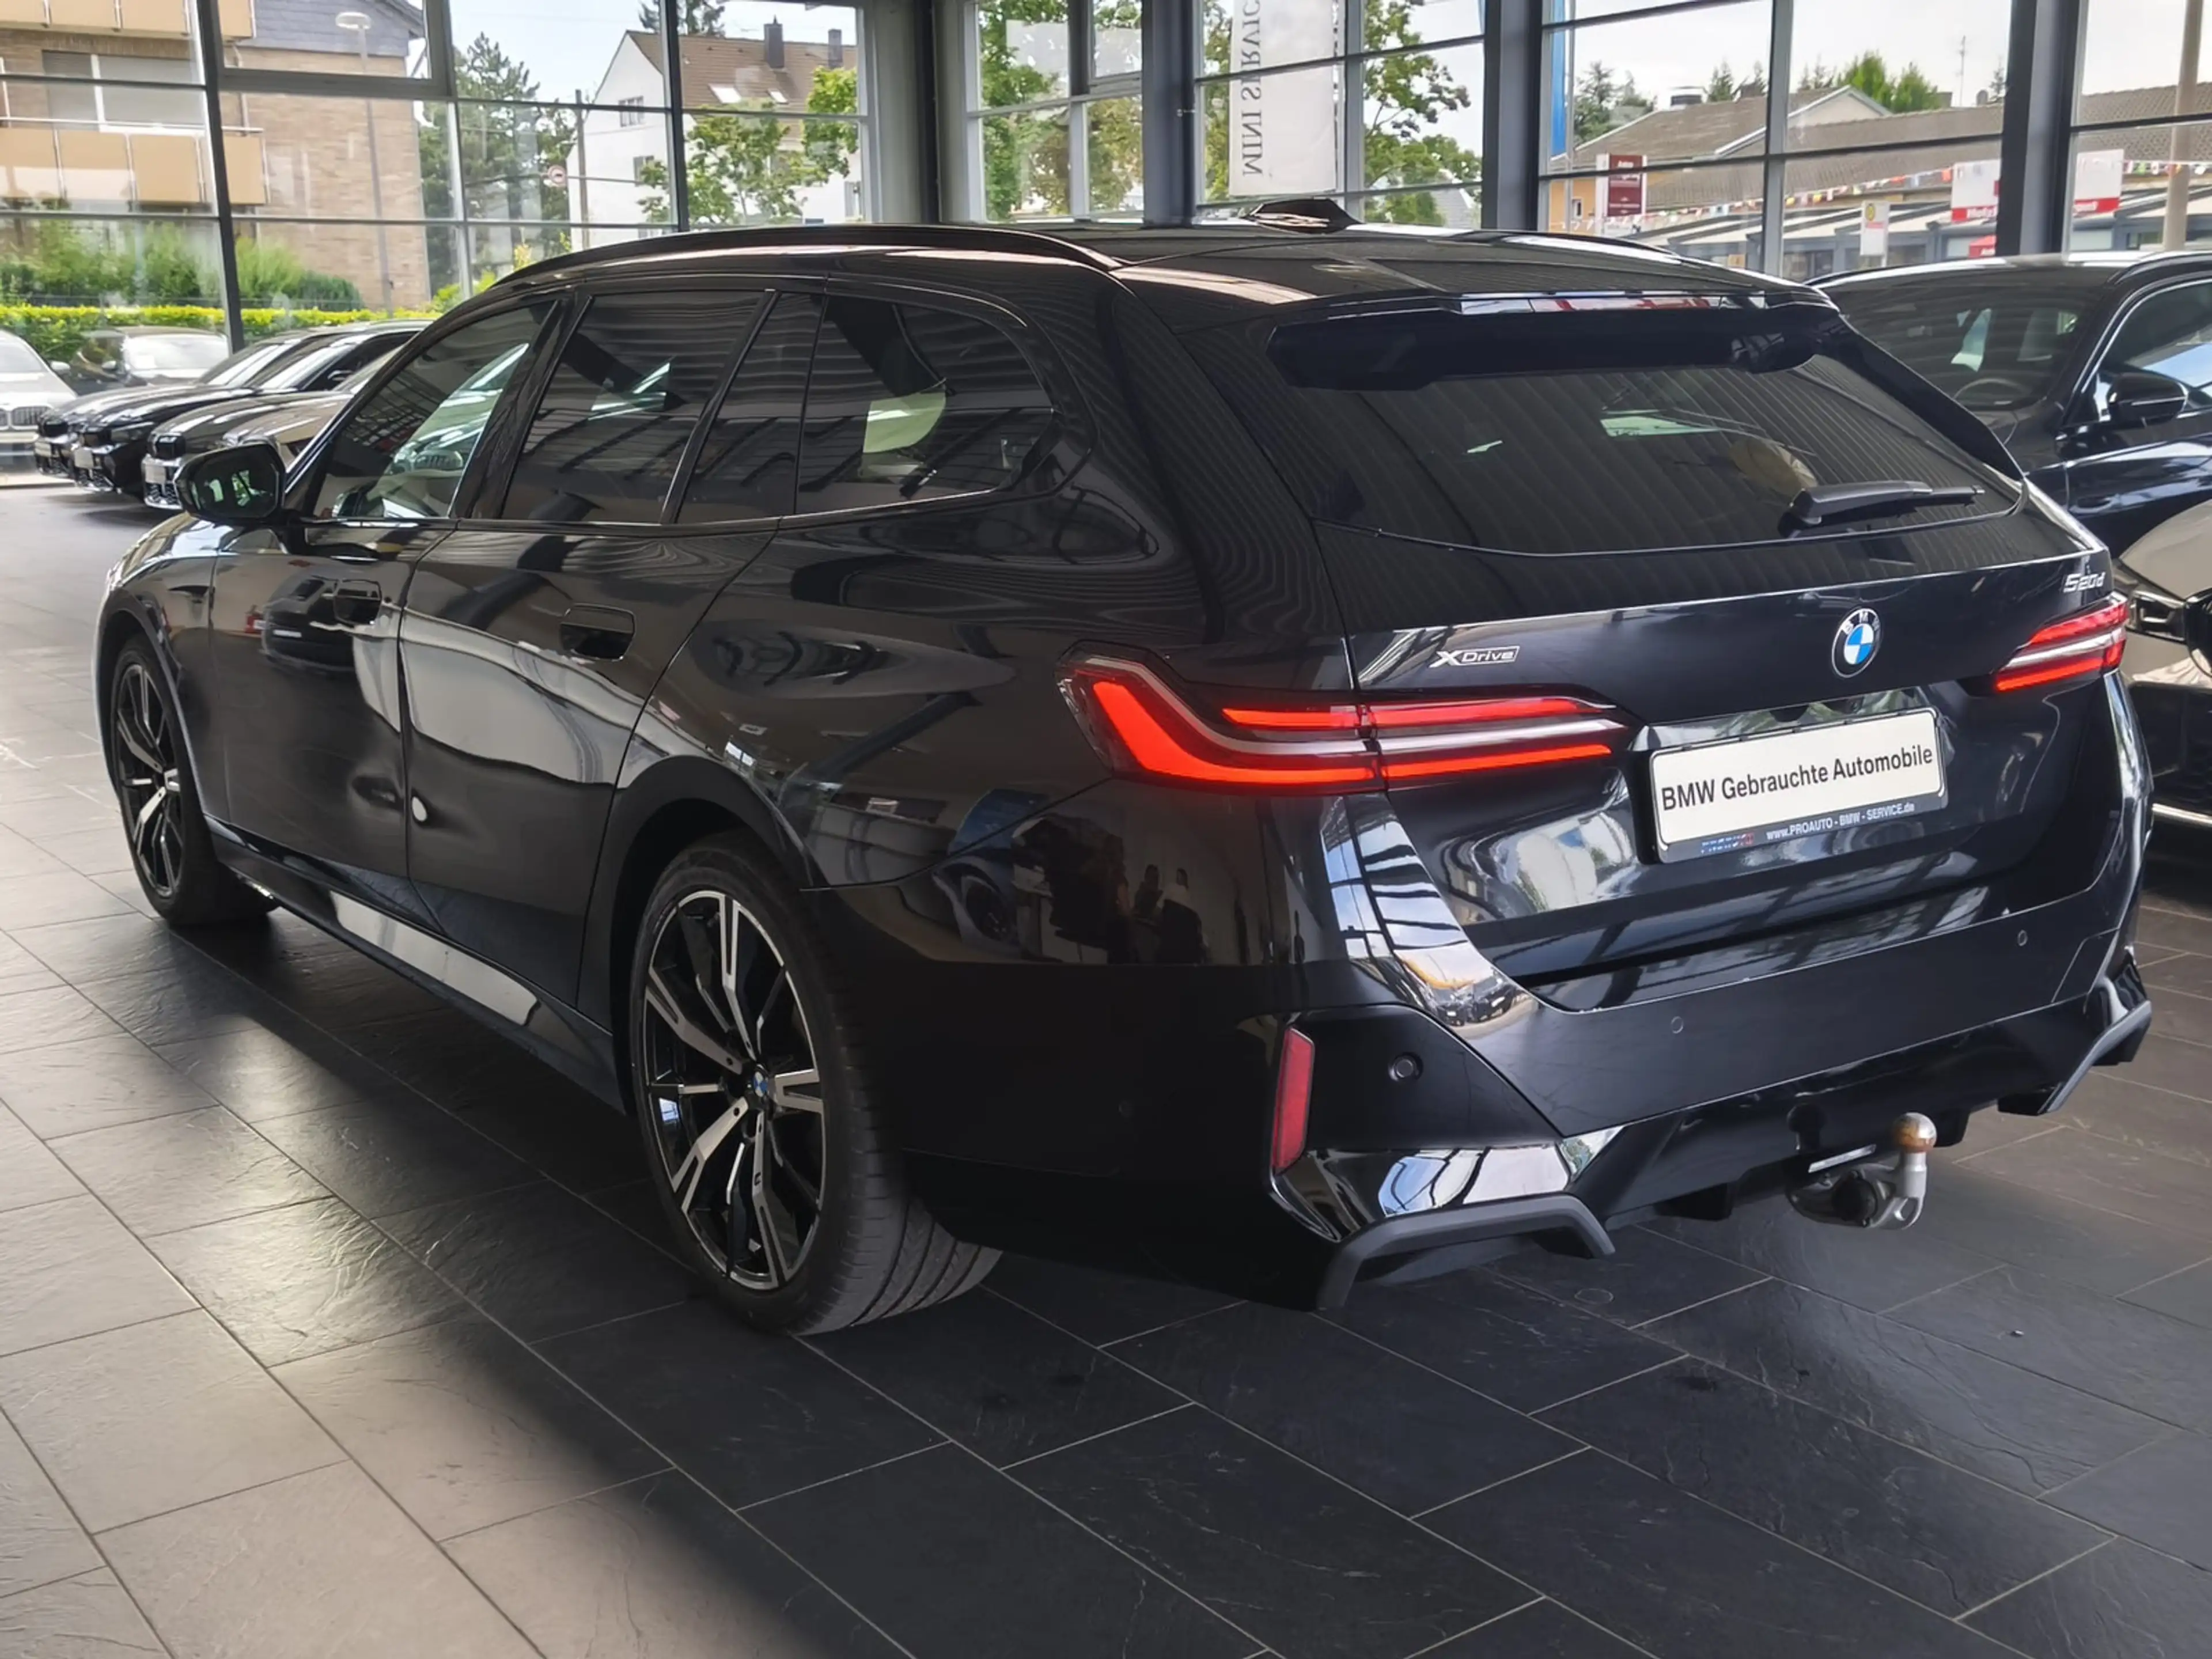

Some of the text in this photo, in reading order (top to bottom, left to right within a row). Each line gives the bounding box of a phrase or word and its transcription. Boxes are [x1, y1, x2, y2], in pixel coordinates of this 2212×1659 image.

[2063, 571, 2106, 593] 520d
[1661, 744, 1933, 810] BMW Gebrauchte Automobile
[1766, 820, 1832, 841] www.PROAUTO
[1839, 811, 1861, 826] BMW
[1867, 804, 1915, 820] SERVICE.de
